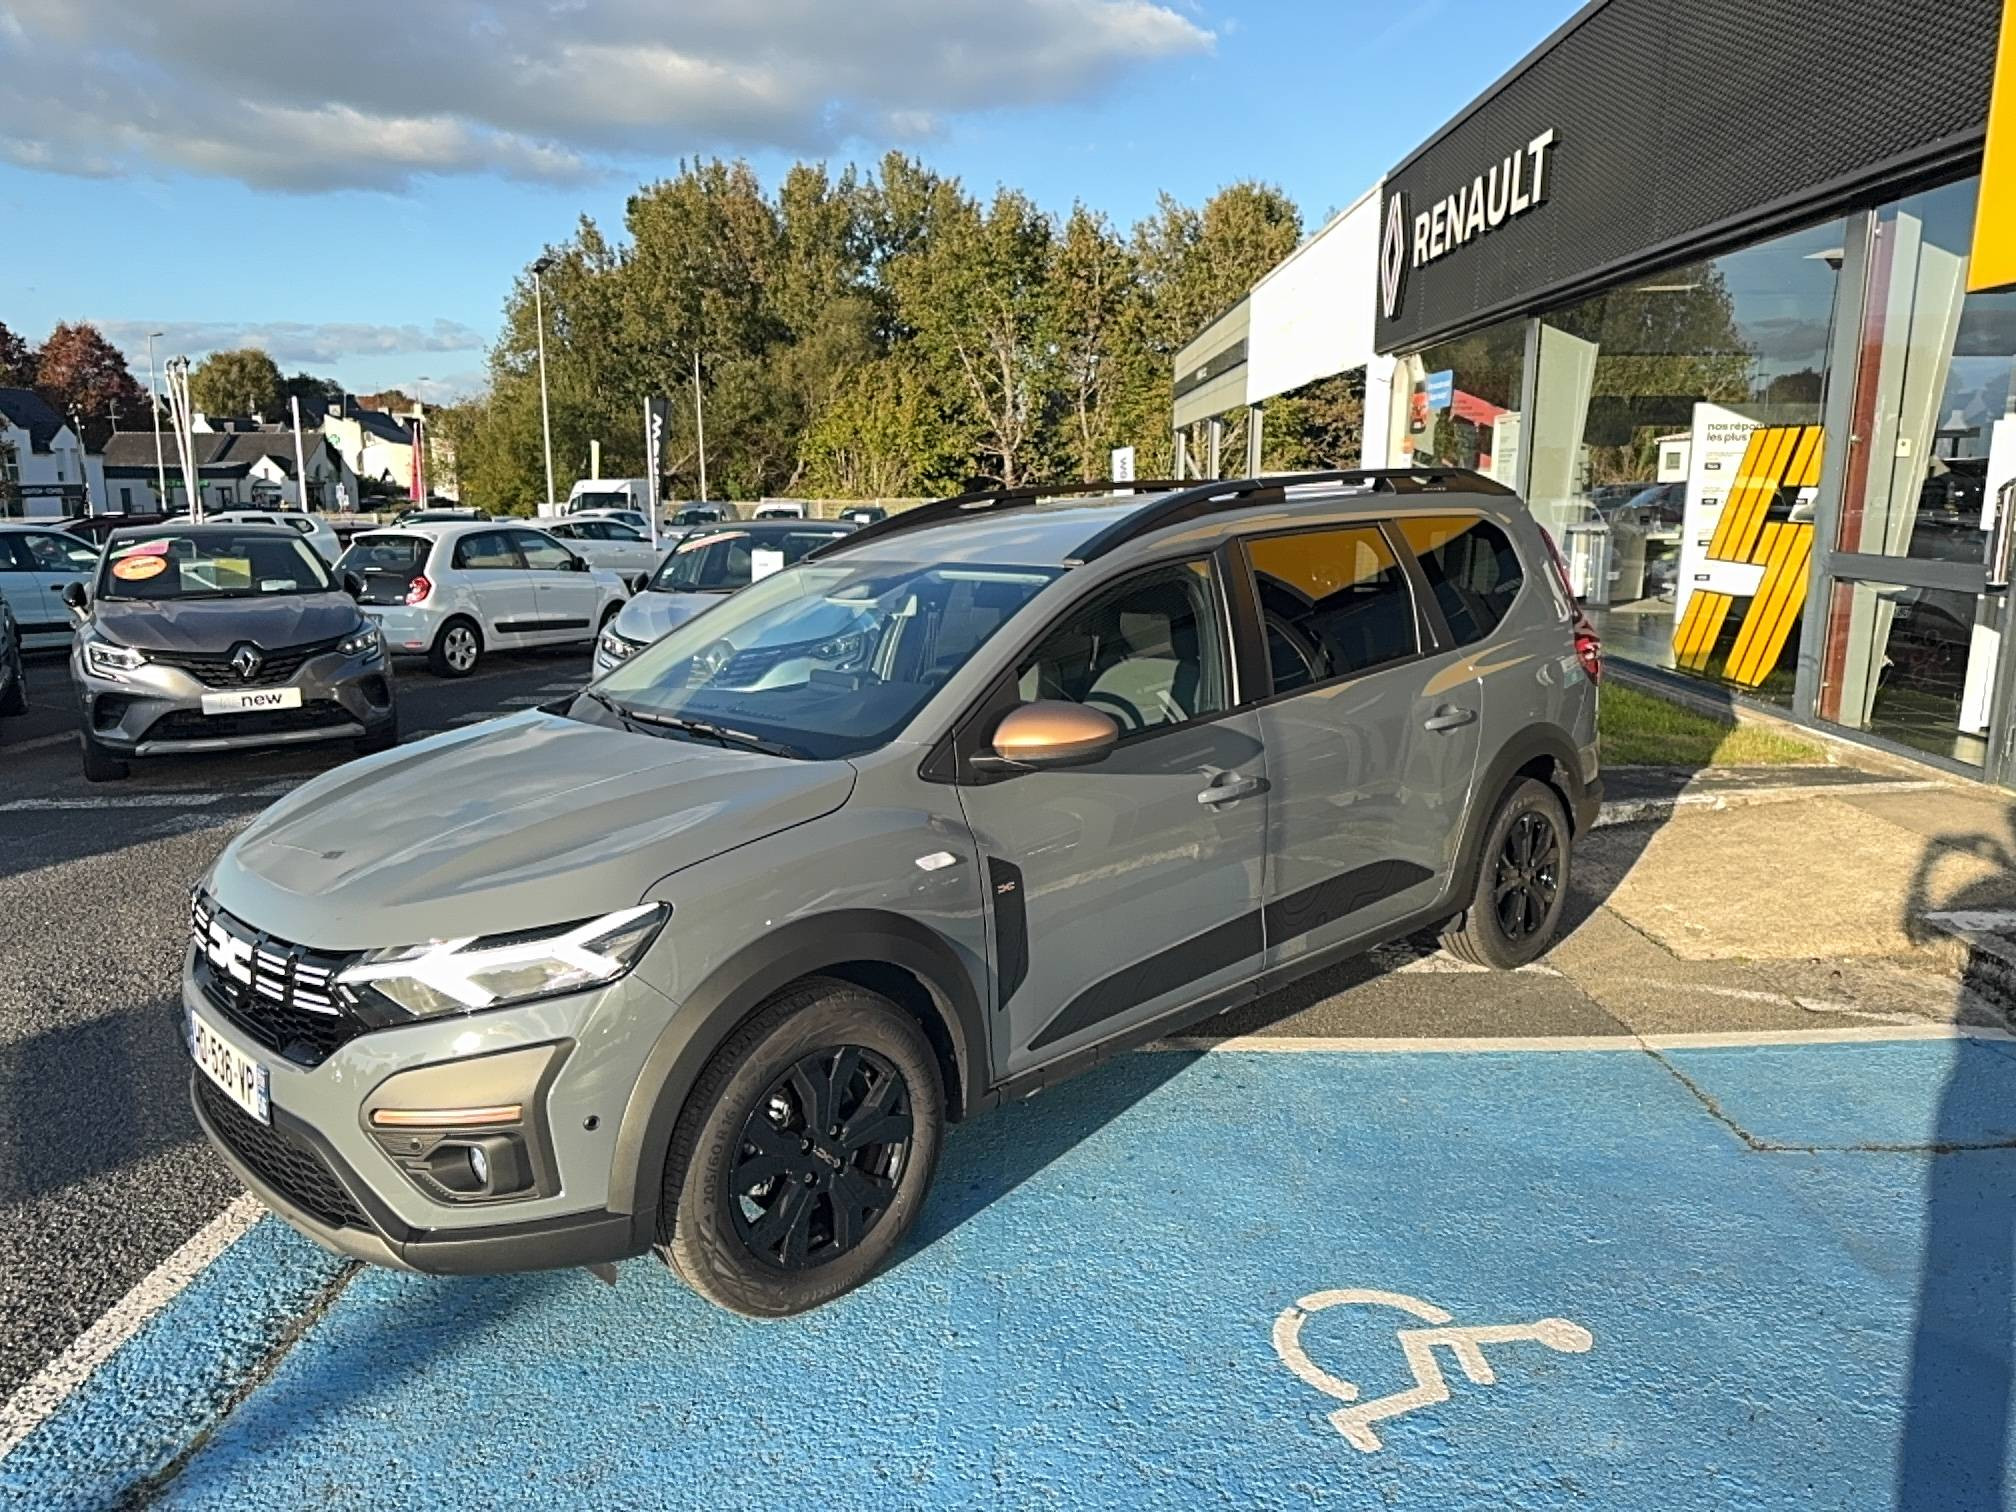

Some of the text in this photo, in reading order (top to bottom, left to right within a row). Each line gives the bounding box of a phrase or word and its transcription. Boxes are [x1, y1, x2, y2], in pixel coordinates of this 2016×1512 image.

[1413, 128, 1554, 268] RENAULT
[1706, 432, 1747, 444] les plus
[1707, 423, 1728, 431] nos
[703, 1144, 723, 1204] 205/60
